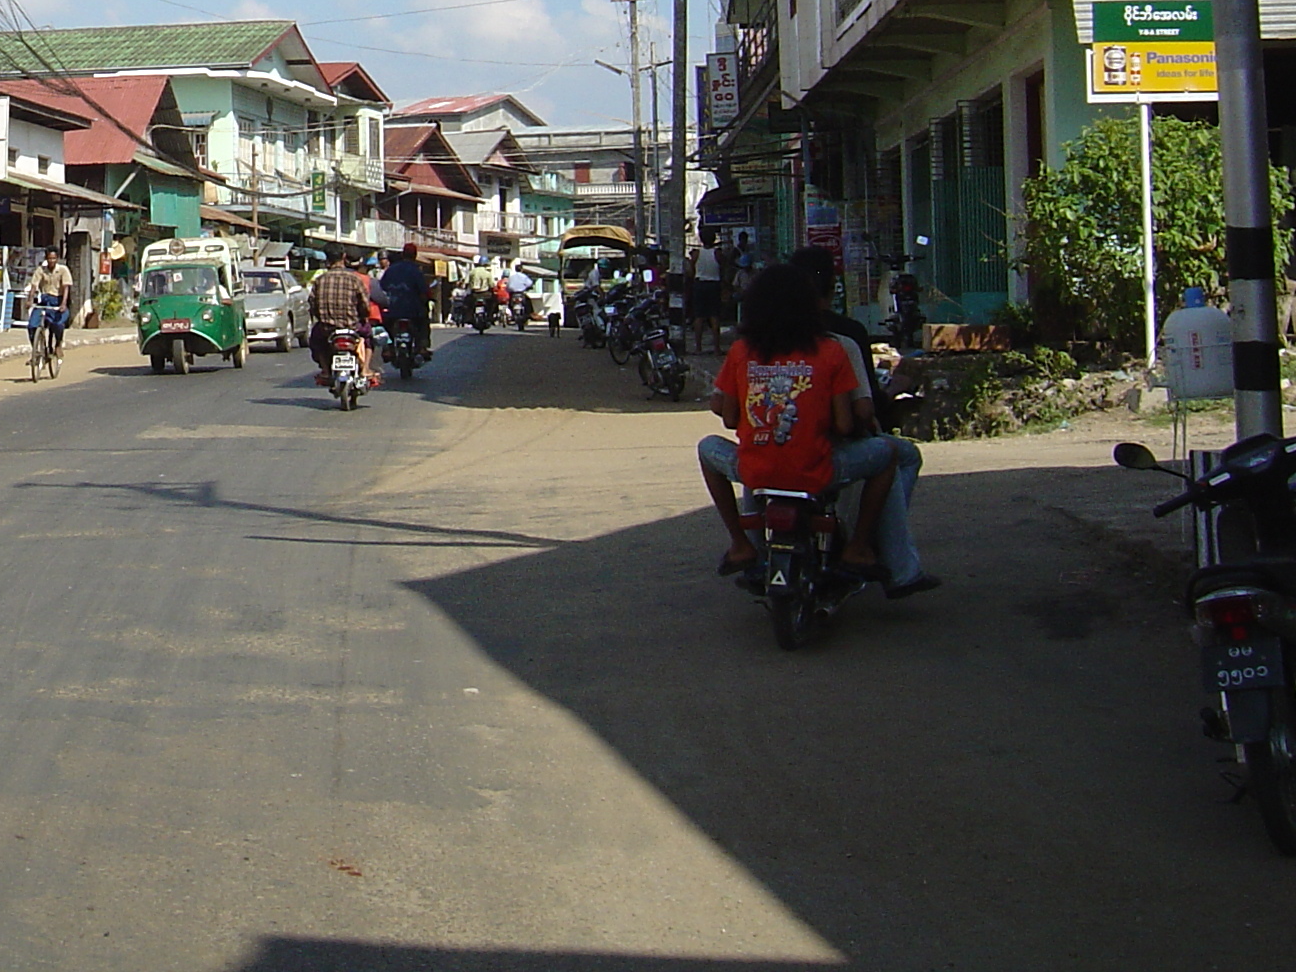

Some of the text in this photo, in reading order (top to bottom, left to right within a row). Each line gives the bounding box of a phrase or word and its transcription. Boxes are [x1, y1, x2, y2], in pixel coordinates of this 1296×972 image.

[1156, 69, 1215, 78] ideas for life
